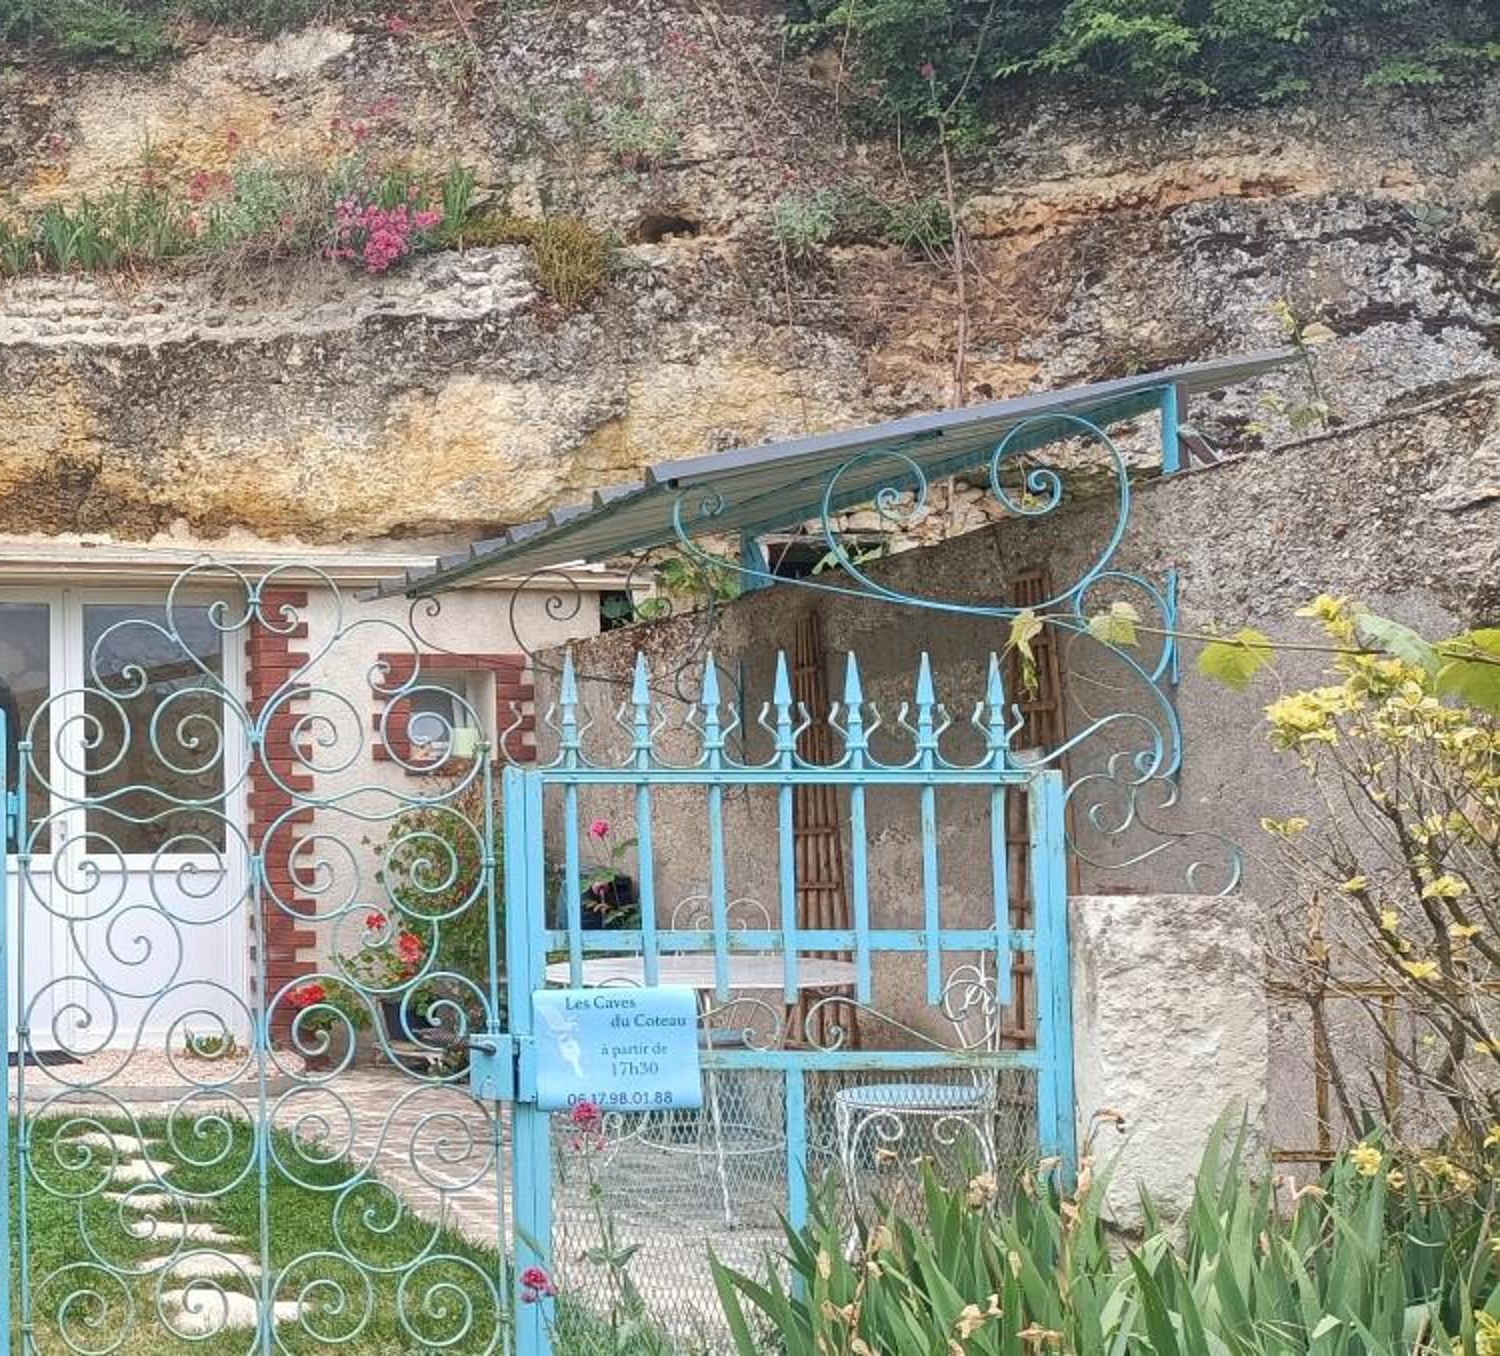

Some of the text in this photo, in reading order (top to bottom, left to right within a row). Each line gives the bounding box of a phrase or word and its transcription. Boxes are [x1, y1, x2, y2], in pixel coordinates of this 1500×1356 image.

[565, 997, 636, 1011] Les Caves
[610, 1013, 687, 1028] du Coteau
[612, 1043, 648, 1059] partir
[651, 1042, 668, 1055] de
[611, 1062, 659, 1077] 17h30
[567, 1091, 673, 1105] 0617.98.01.88
